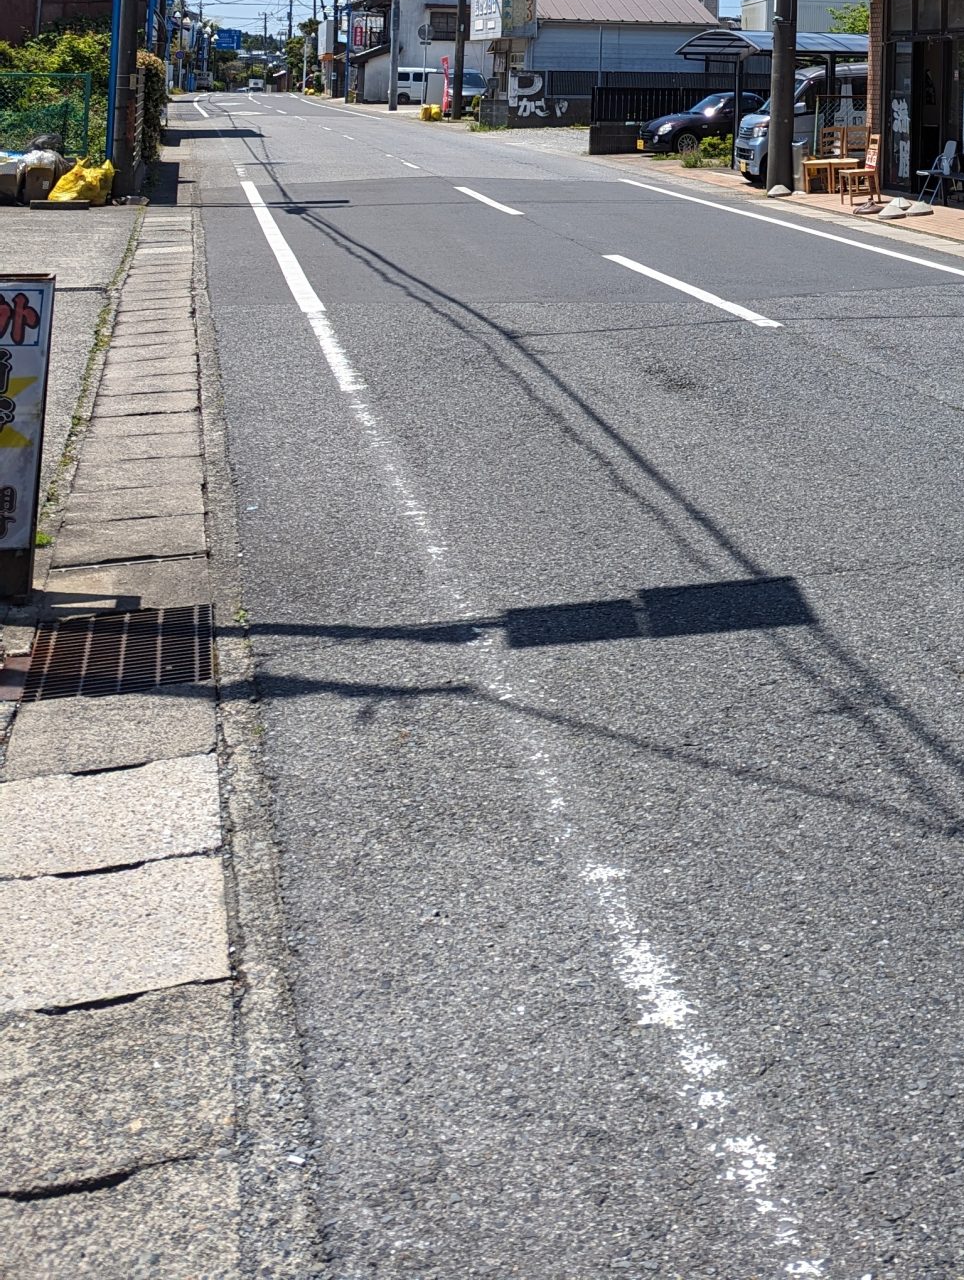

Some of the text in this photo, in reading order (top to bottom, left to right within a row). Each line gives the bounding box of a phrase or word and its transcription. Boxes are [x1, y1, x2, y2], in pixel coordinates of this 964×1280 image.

[508, 70, 543, 107] P
[518, 98, 569, 118] かさや
